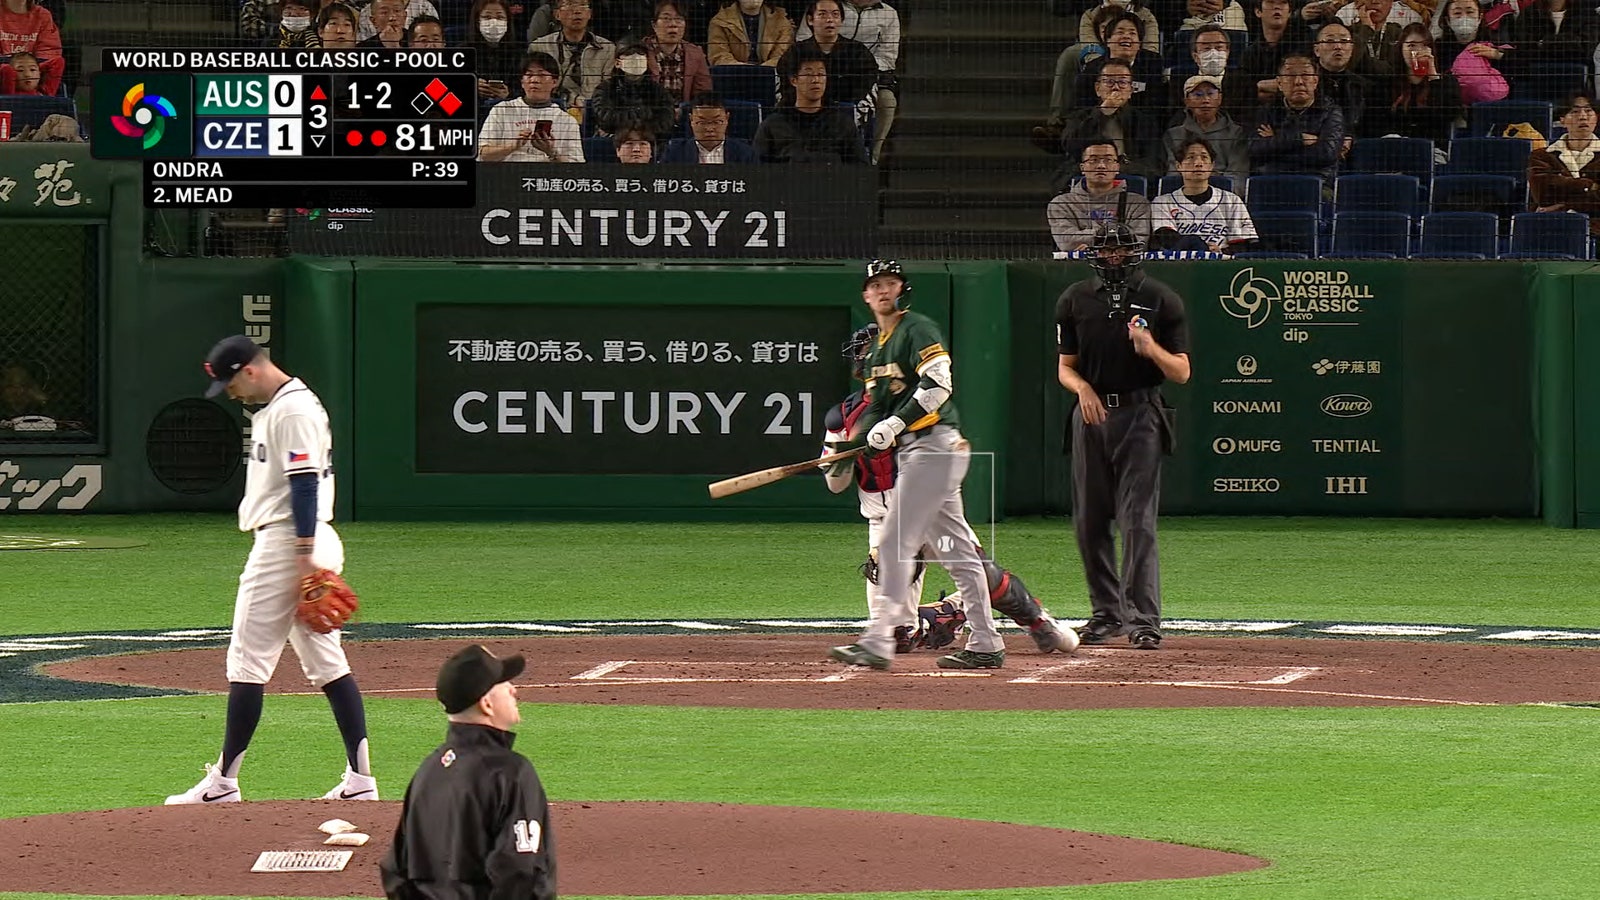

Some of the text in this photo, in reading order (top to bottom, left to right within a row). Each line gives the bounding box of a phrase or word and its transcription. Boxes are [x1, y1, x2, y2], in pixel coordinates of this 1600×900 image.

[480, 208, 786, 247] CENTURY 21
[1283, 271, 1349, 285] WORLD
[1283, 285, 1374, 299] BASEBALL
[1283, 299, 1360, 312] CLASSIC
[1283, 313, 1314, 321] TOKYO
[1283, 328, 1309, 343] dip
[448, 340, 820, 363] 不動産の売る、買う、借りる、貸すは
[1335, 360, 1381, 374] 伊藤園
[1213, 401, 1281, 413] KONAMI
[1325, 398, 1371, 411] Kowa
[452, 391, 813, 435] CENTURY 21
[1238, 440, 1281, 452] MUFG
[1312, 440, 1381, 453] TENTIAL
[1213, 478, 1280, 493] SEIKO
[1325, 476, 1368, 494] IHI
